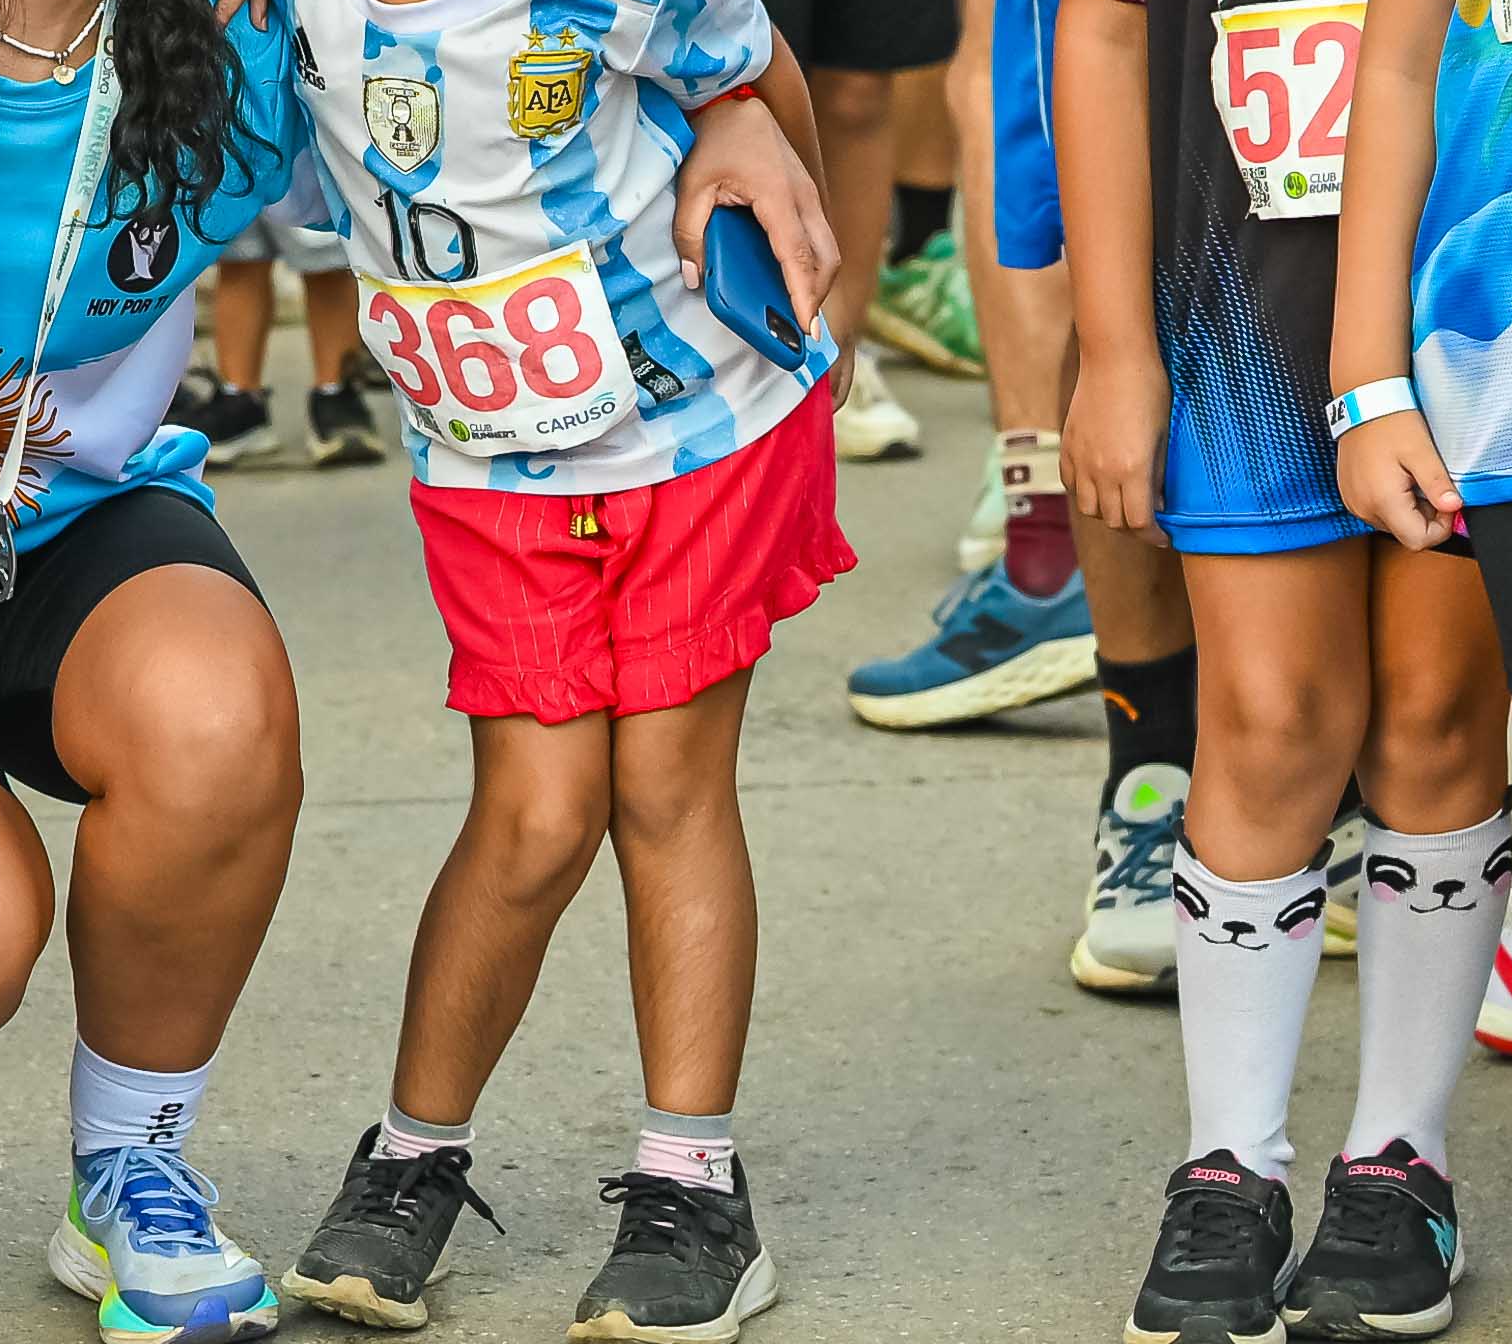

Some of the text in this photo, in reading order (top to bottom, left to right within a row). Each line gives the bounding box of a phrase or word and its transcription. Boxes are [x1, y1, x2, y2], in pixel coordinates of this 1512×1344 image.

[526, 79, 573, 115] AFA
[1310, 173, 1337, 183] CLUB
[374, 189, 480, 282] 10
[86, 298, 116, 317] HOY
[120, 298, 149, 315] POR
[369, 277, 603, 412] 368
[470, 423, 493, 432] CLUB
[536, 401, 616, 435] CARUSO
[1188, 1167, 1241, 1185] Kappa
[1348, 1164, 1407, 1181] Kappa
